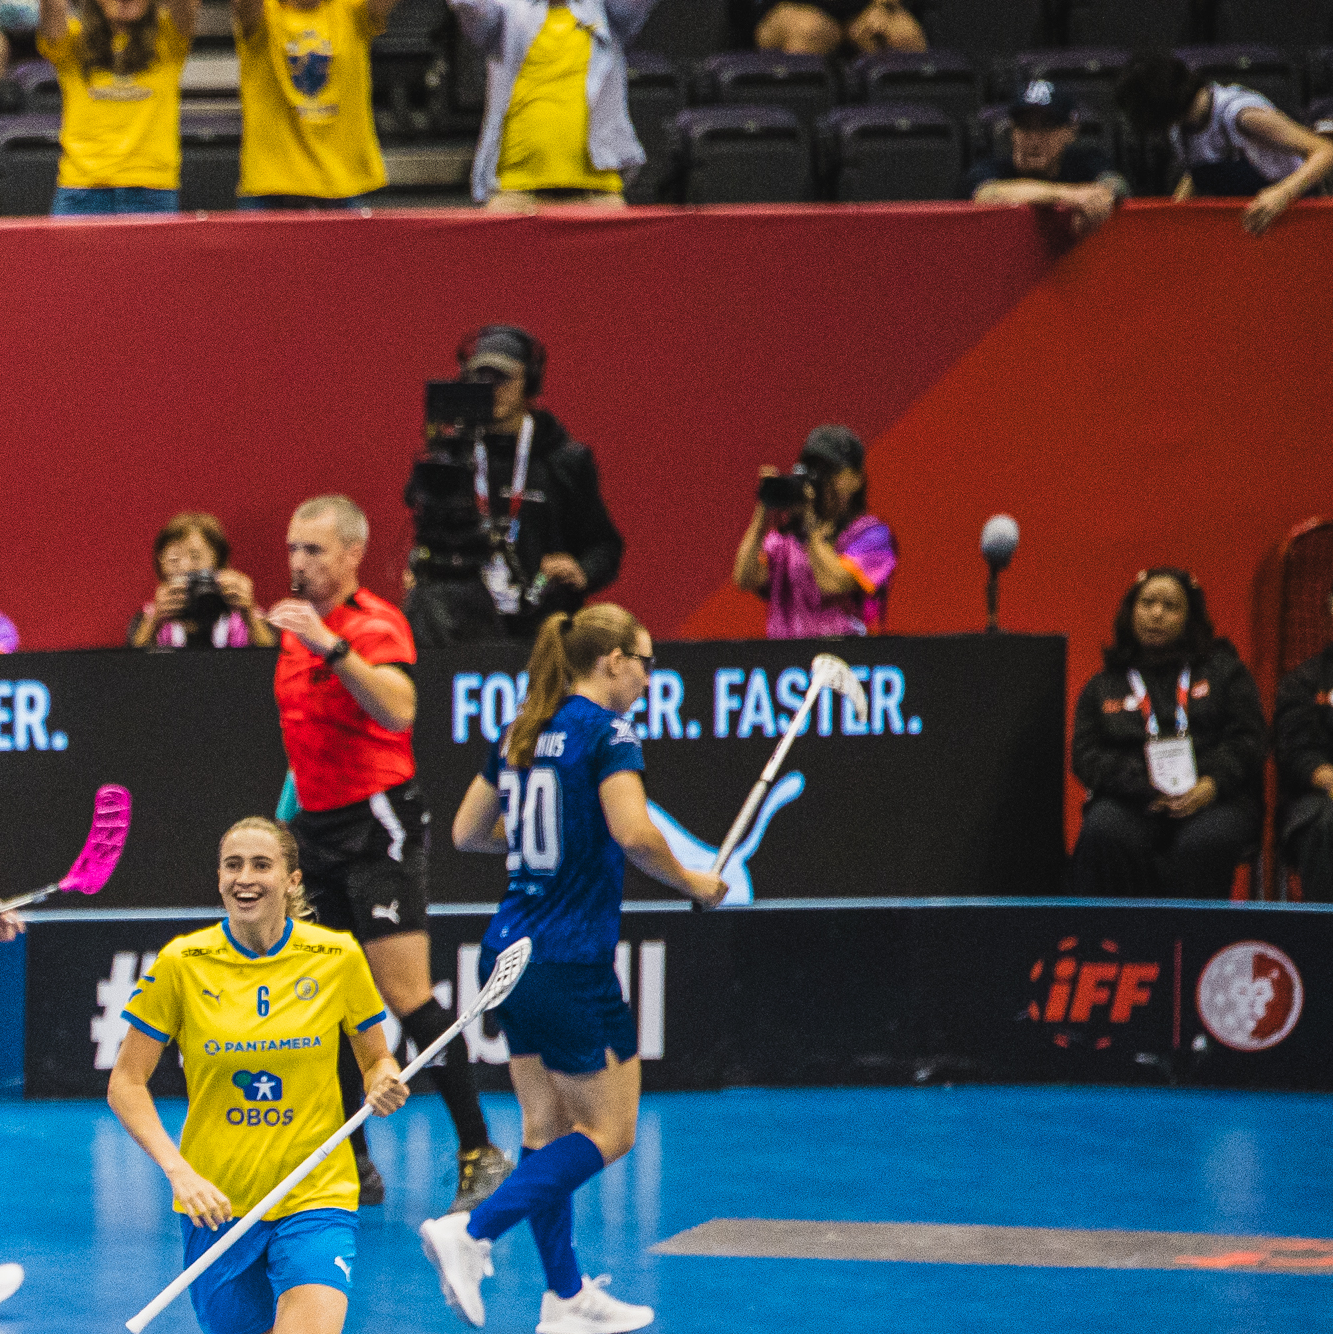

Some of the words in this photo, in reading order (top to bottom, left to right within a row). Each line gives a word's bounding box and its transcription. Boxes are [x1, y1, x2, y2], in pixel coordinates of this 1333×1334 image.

[498, 766, 563, 877] 20
[292, 943, 342, 956] stadium
[256, 985, 270, 1018] 6
[224, 1036, 322, 1053] PANTAMERA
[225, 1107, 294, 1127] OBOS
